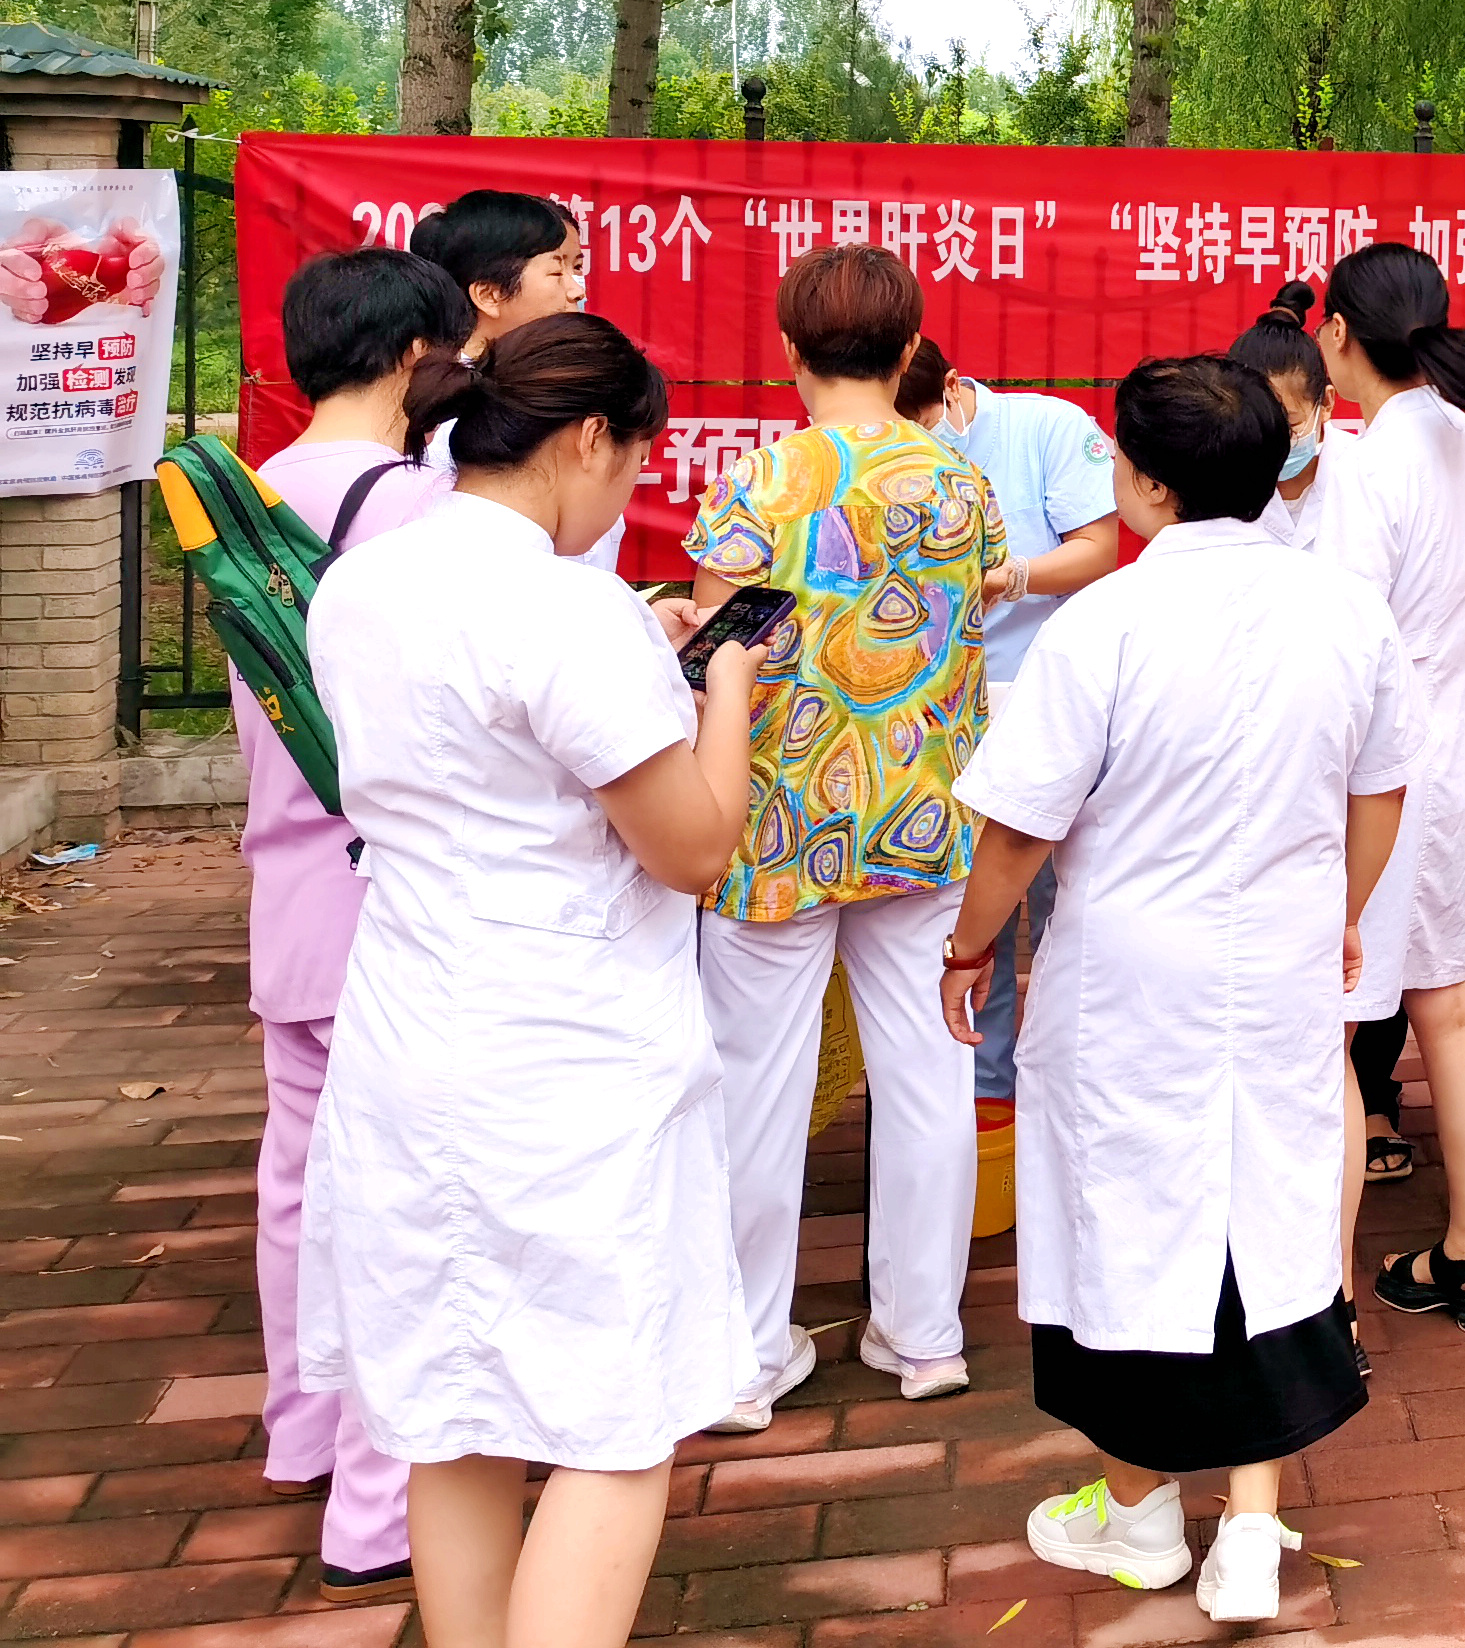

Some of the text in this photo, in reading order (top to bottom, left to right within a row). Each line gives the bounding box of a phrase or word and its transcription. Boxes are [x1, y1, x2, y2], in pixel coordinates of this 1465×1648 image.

[16, 366, 136, 392] 加强检测发现
